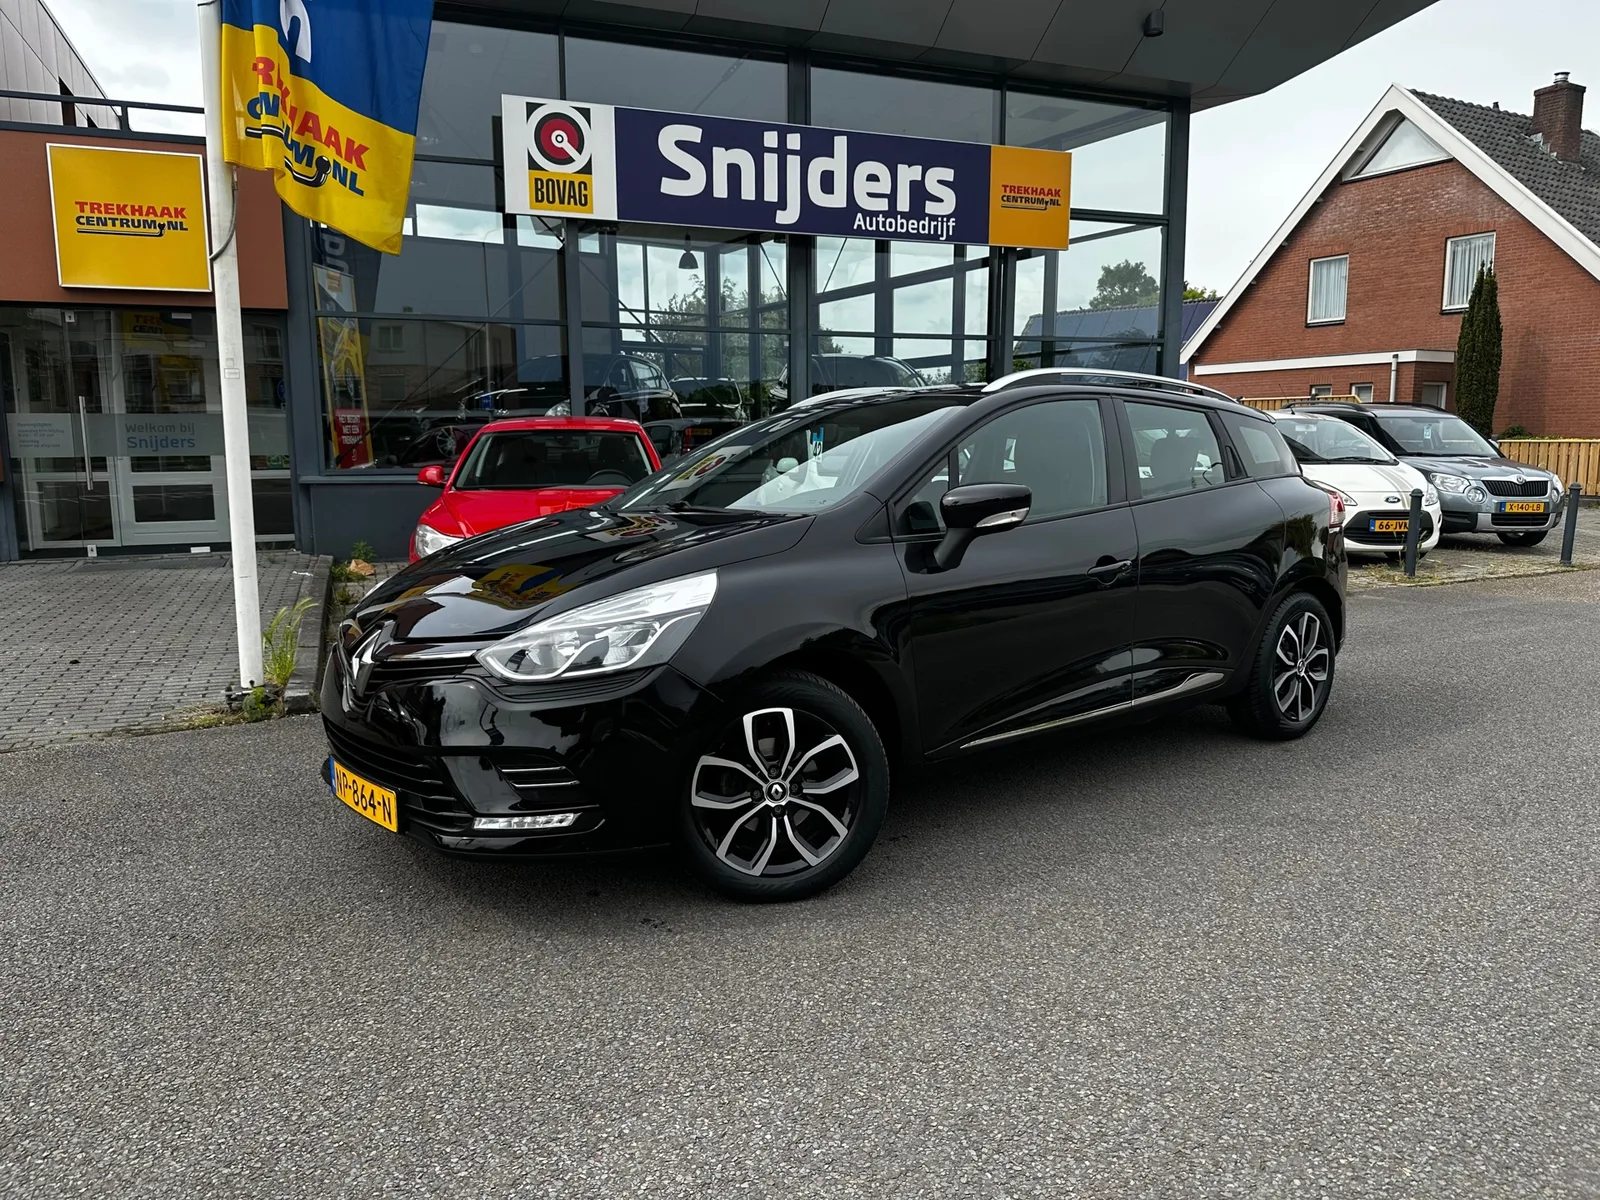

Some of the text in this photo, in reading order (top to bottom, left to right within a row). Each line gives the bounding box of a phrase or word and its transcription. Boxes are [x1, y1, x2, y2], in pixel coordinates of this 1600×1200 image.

[657, 123, 957, 225] Snijders
[534, 177, 589, 207] BOVAG
[1001, 184, 1062, 198] TREKHAAK
[74, 200, 188, 219] TREKHAAK
[853, 213, 957, 240] Autobedrijf
[125, 422, 196, 435] Welkom bij
[127, 436, 195, 451] Snijders
[1508, 503, 1541, 512] X-140-LB
[335, 766, 393, 826] NP-864-N
